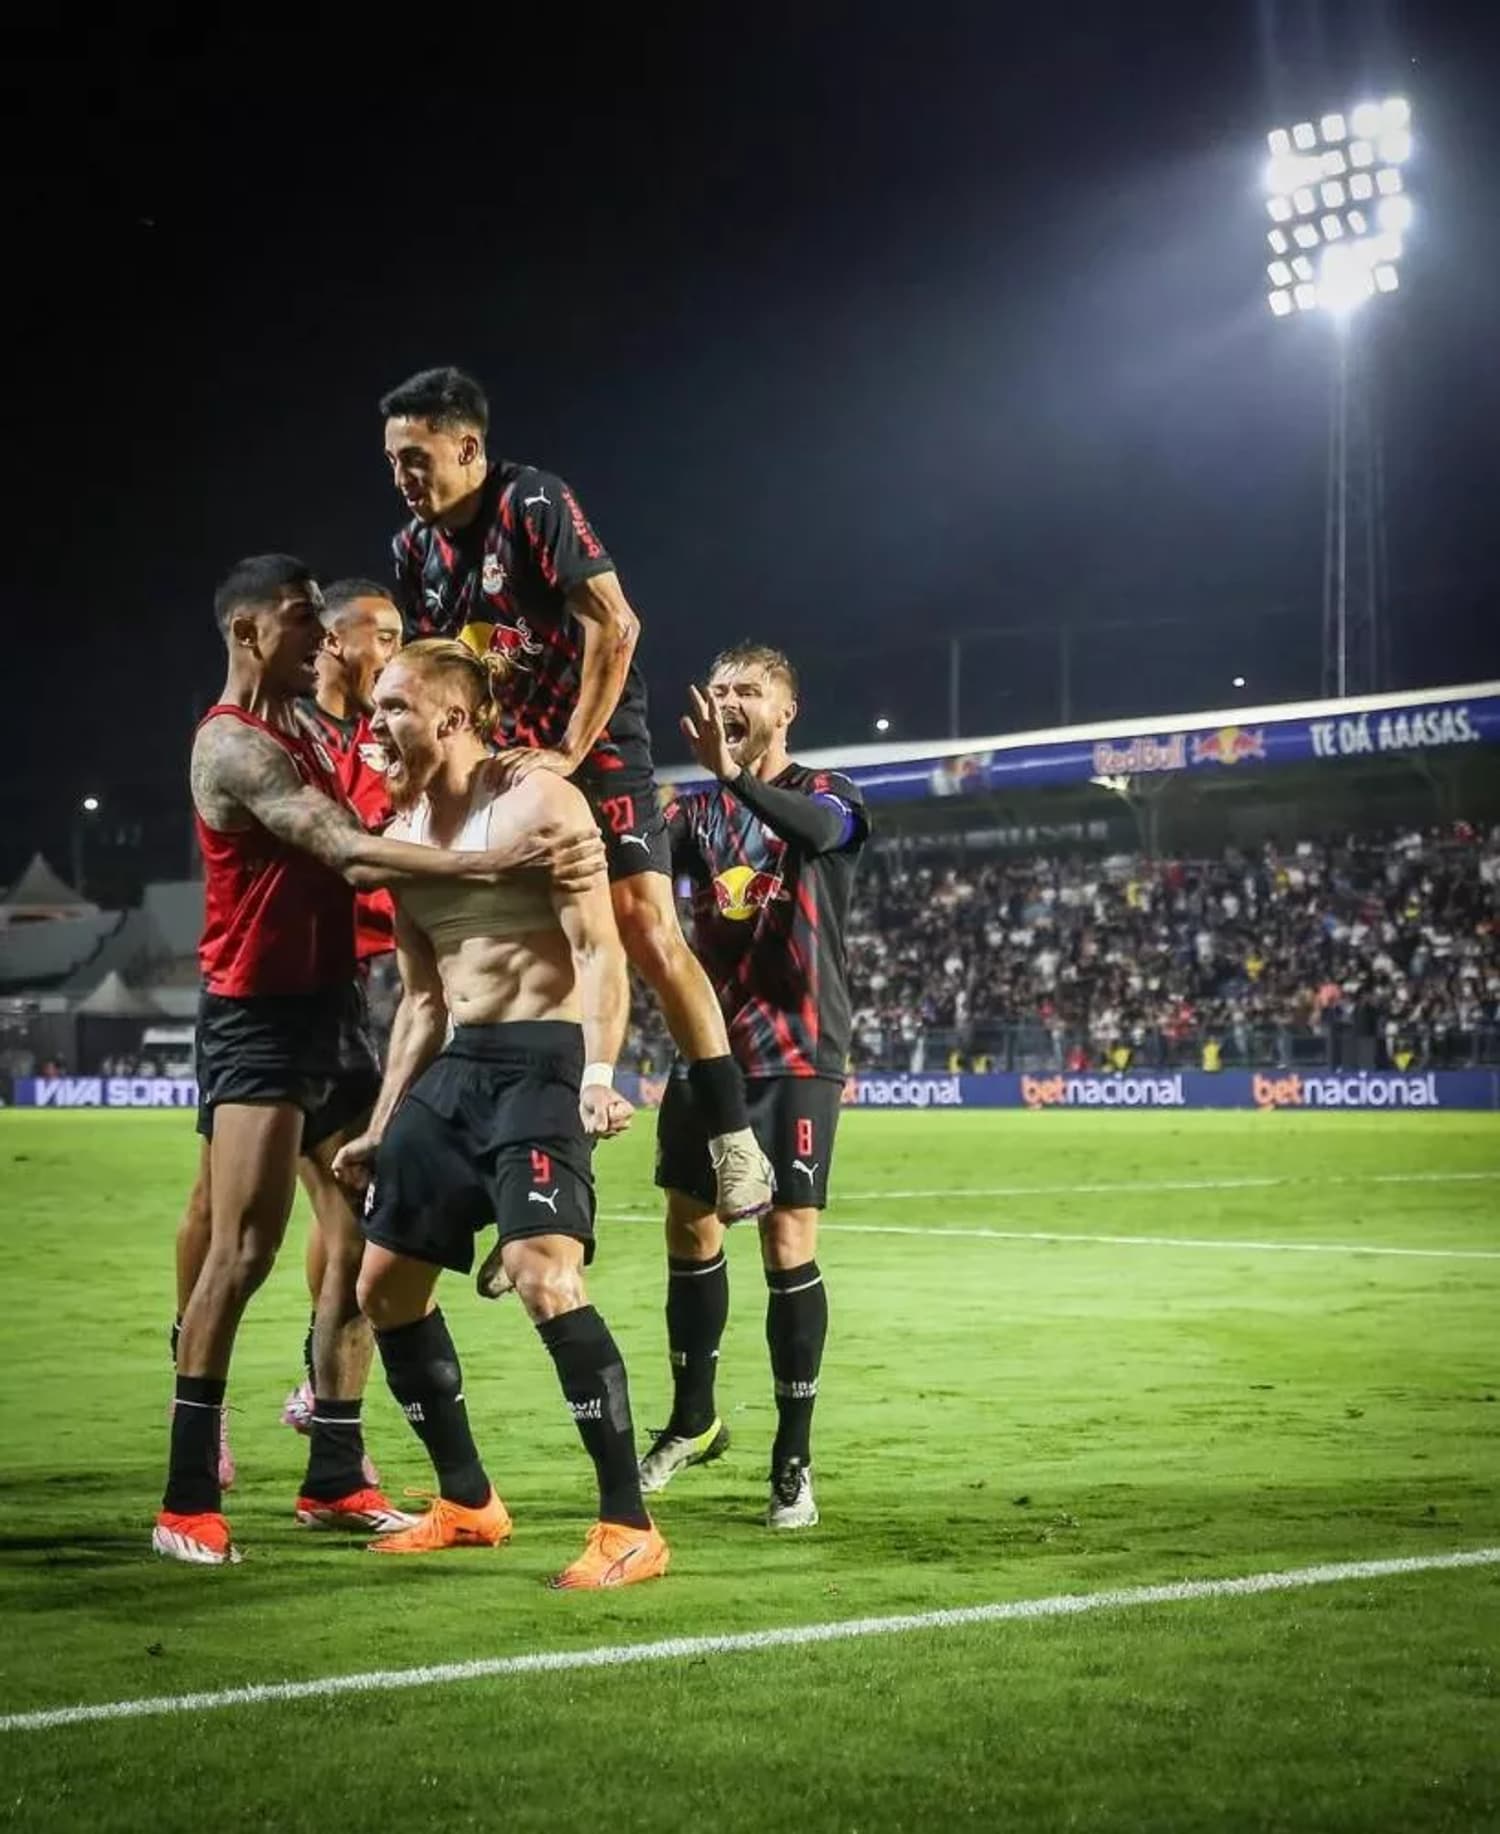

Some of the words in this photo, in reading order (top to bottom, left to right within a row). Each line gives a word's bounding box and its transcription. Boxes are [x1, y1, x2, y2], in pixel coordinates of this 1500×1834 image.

[1310, 722, 1337, 756] TE
[1378, 707, 1480, 750] AAASAS.
[602, 796, 634, 832] 27
[35, 1078, 101, 1106] VIVA
[798, 1119, 812, 1156] 8
